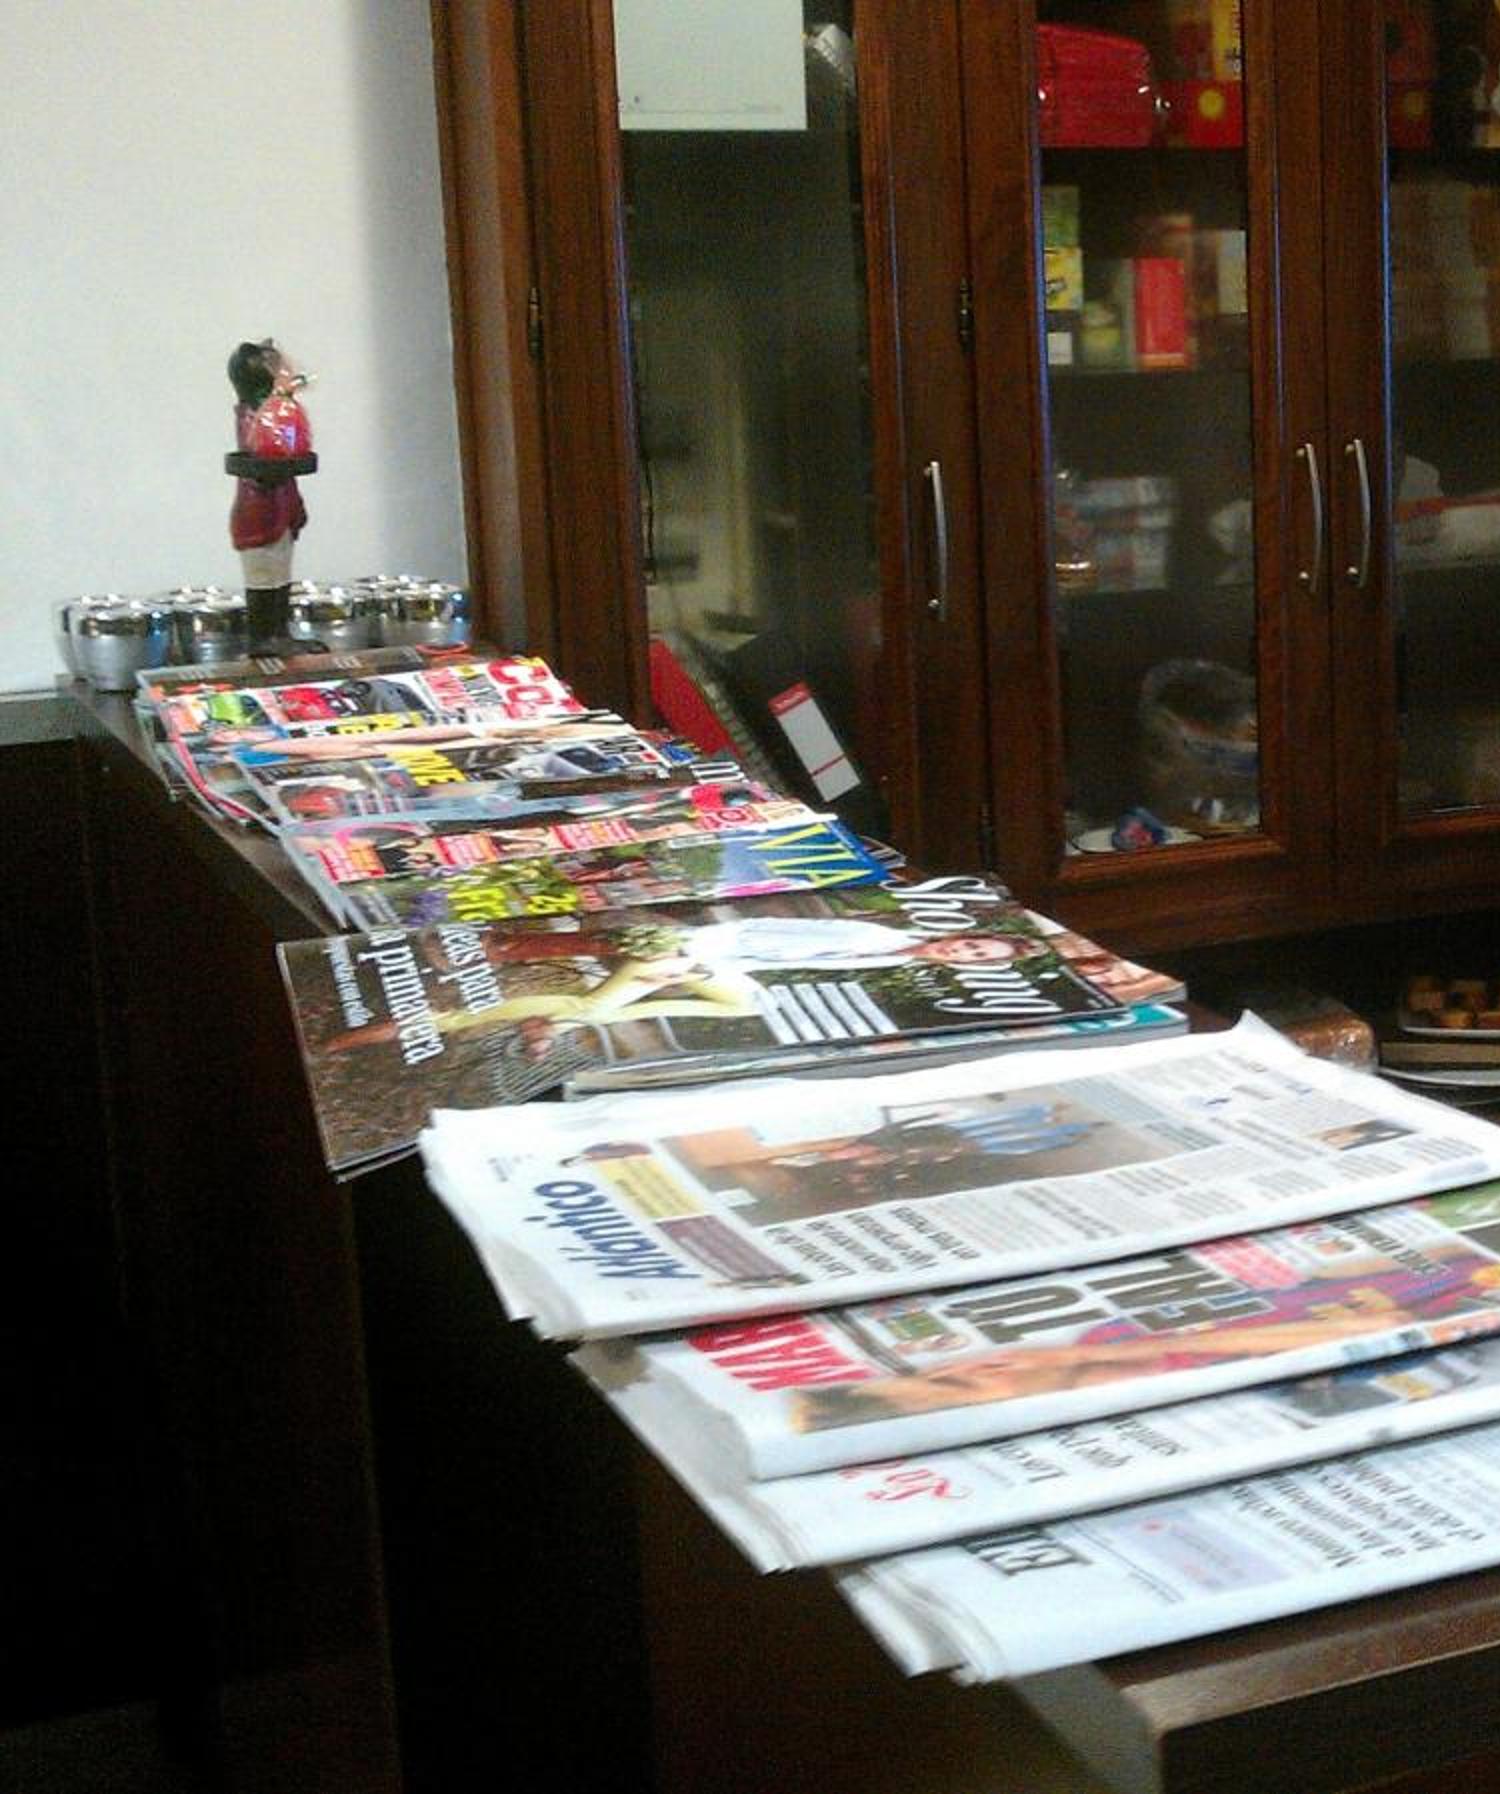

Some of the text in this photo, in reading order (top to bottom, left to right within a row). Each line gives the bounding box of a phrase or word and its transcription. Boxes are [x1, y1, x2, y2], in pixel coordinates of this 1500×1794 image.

[437, 961, 504, 1016] para
[879, 876, 1063, 1014] Shoing
[357, 945, 446, 1065] primavera
[523, 1168, 704, 1279] Atlántico
